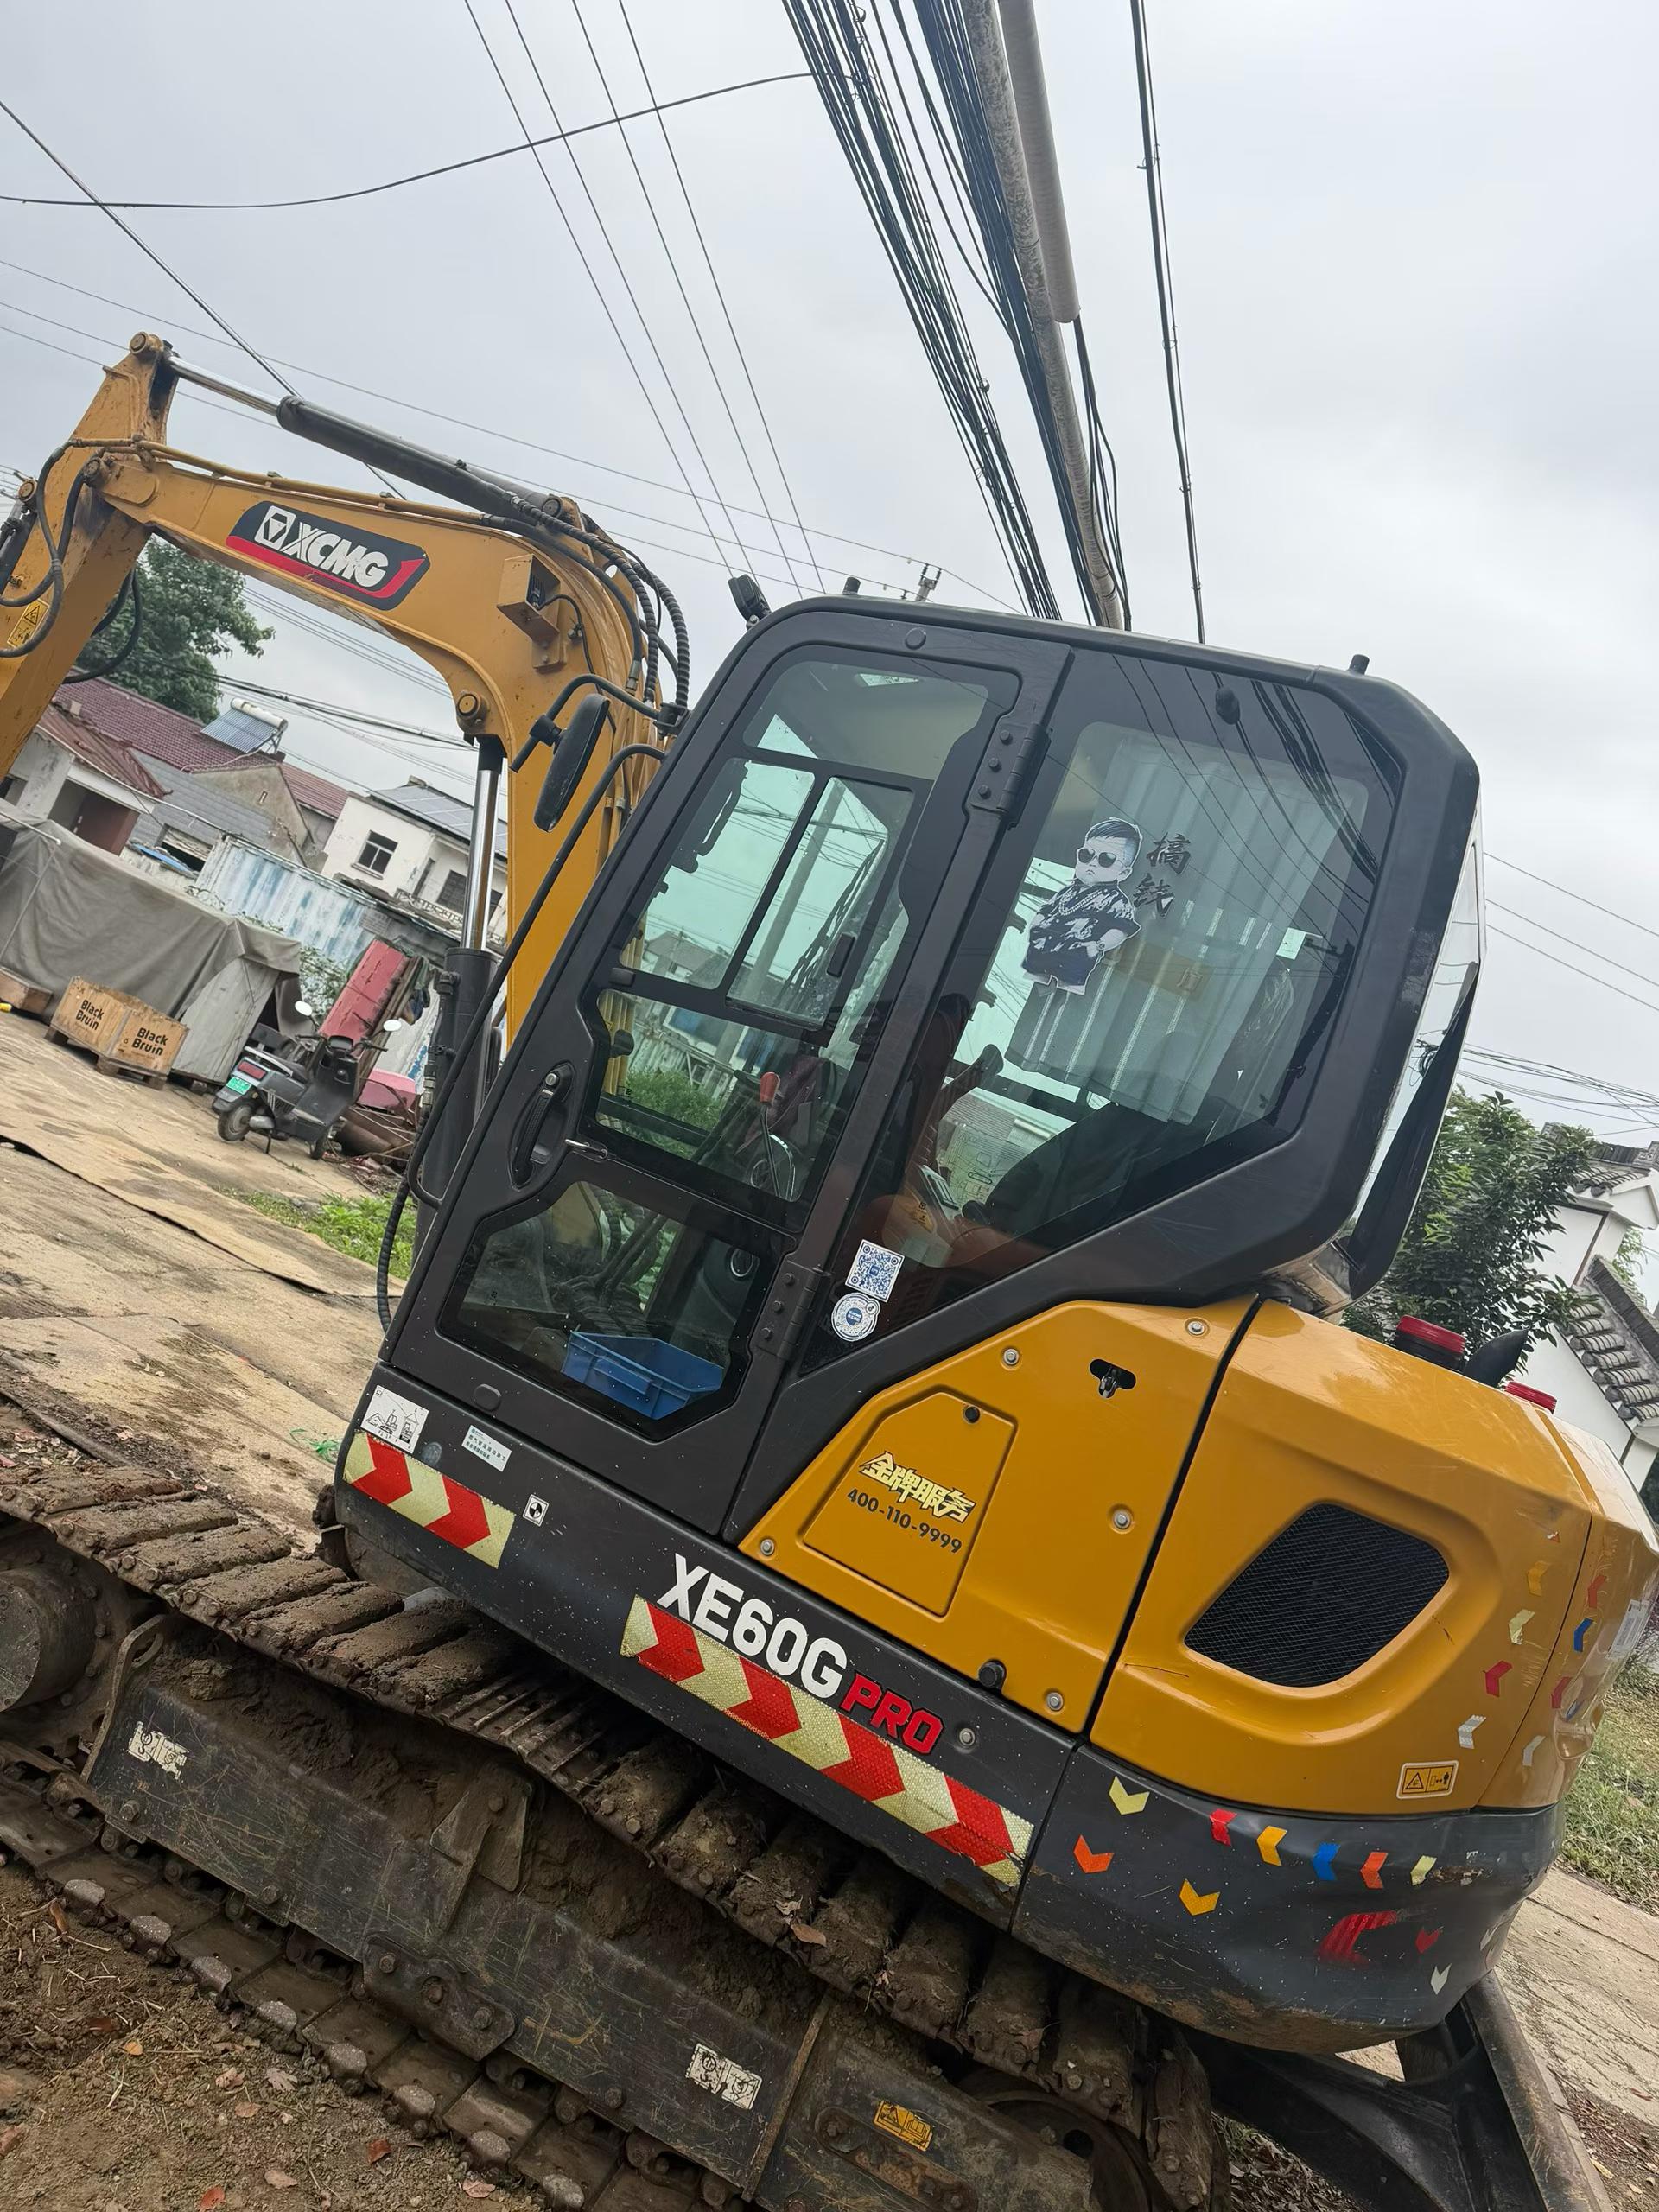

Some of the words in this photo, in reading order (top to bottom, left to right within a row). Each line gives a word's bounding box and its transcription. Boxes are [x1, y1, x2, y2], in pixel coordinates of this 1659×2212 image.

[279, 521, 389, 588] XCMG
[80, 999, 105, 1020] Black
[137, 1027, 168, 1046] Black
[131, 1038, 164, 1056] Bruin
[859, 1451, 976, 1523] 金牌服务
[848, 1489, 962, 1554] 400-110-9999
[657, 1553, 847, 1699] XE60G
[839, 1670, 944, 1755] PRO
